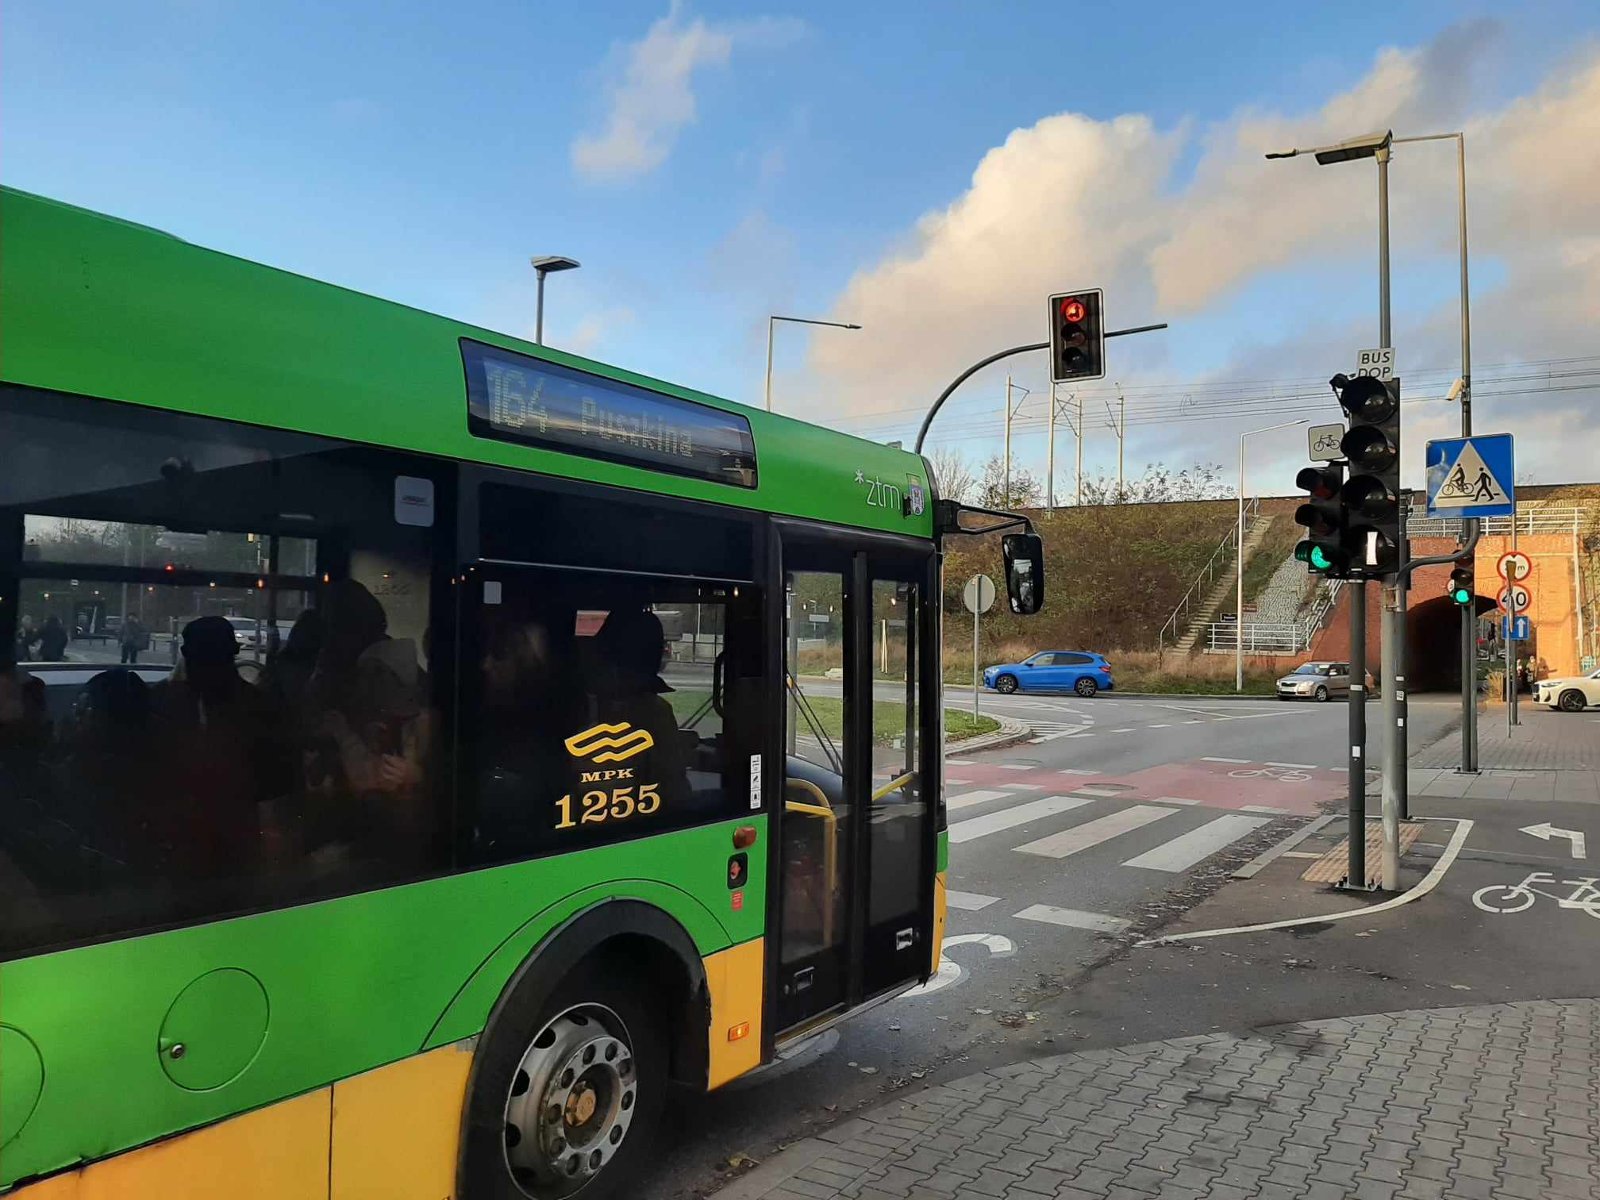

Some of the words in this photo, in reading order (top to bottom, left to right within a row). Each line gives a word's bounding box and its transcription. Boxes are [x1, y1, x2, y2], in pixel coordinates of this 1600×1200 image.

[1361, 351, 1391, 364] BUS
[865, 476, 901, 510] ztm
[580, 768, 634, 783] MPK
[555, 783, 661, 829] 1255
